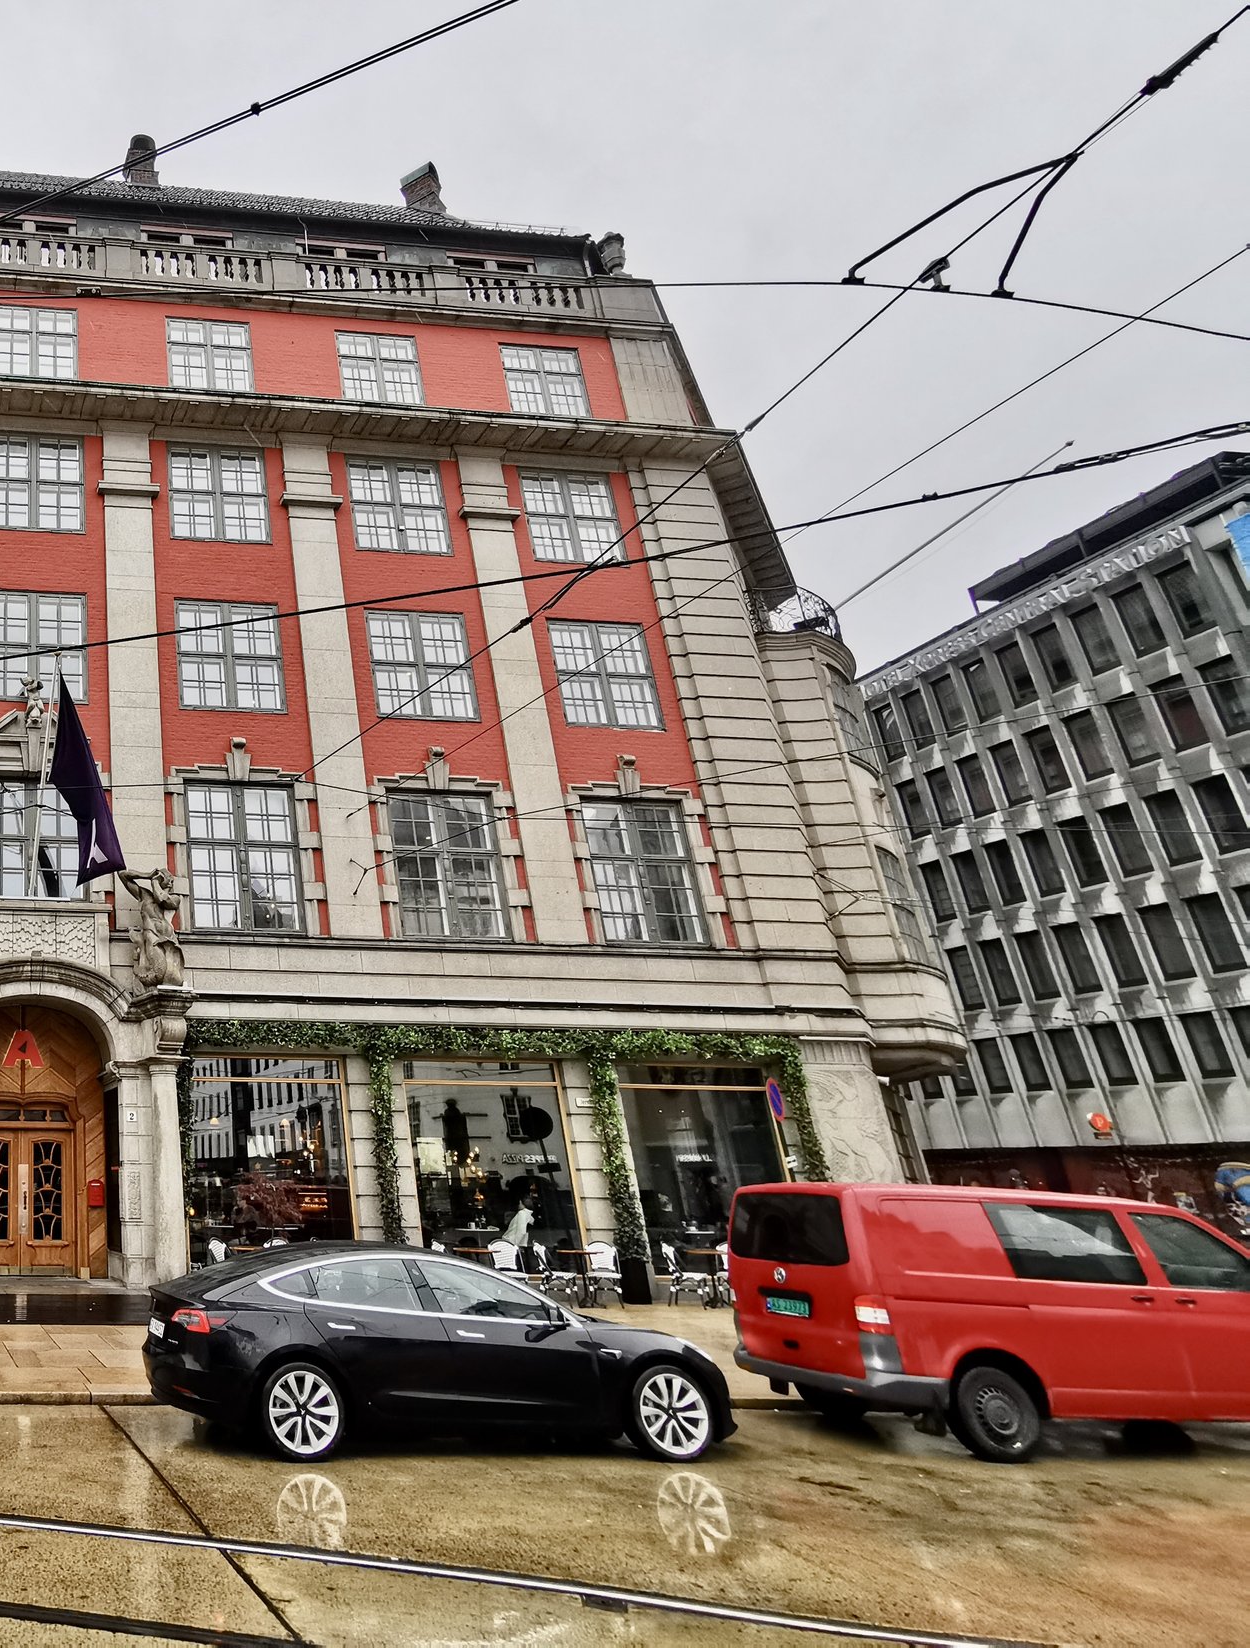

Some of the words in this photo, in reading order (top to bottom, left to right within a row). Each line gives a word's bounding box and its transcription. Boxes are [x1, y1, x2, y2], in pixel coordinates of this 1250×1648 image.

[977, 579, 1087, 646] CENTRAL
[1079, 525, 1192, 590] STATION
[1, 1029, 45, 1069] A
